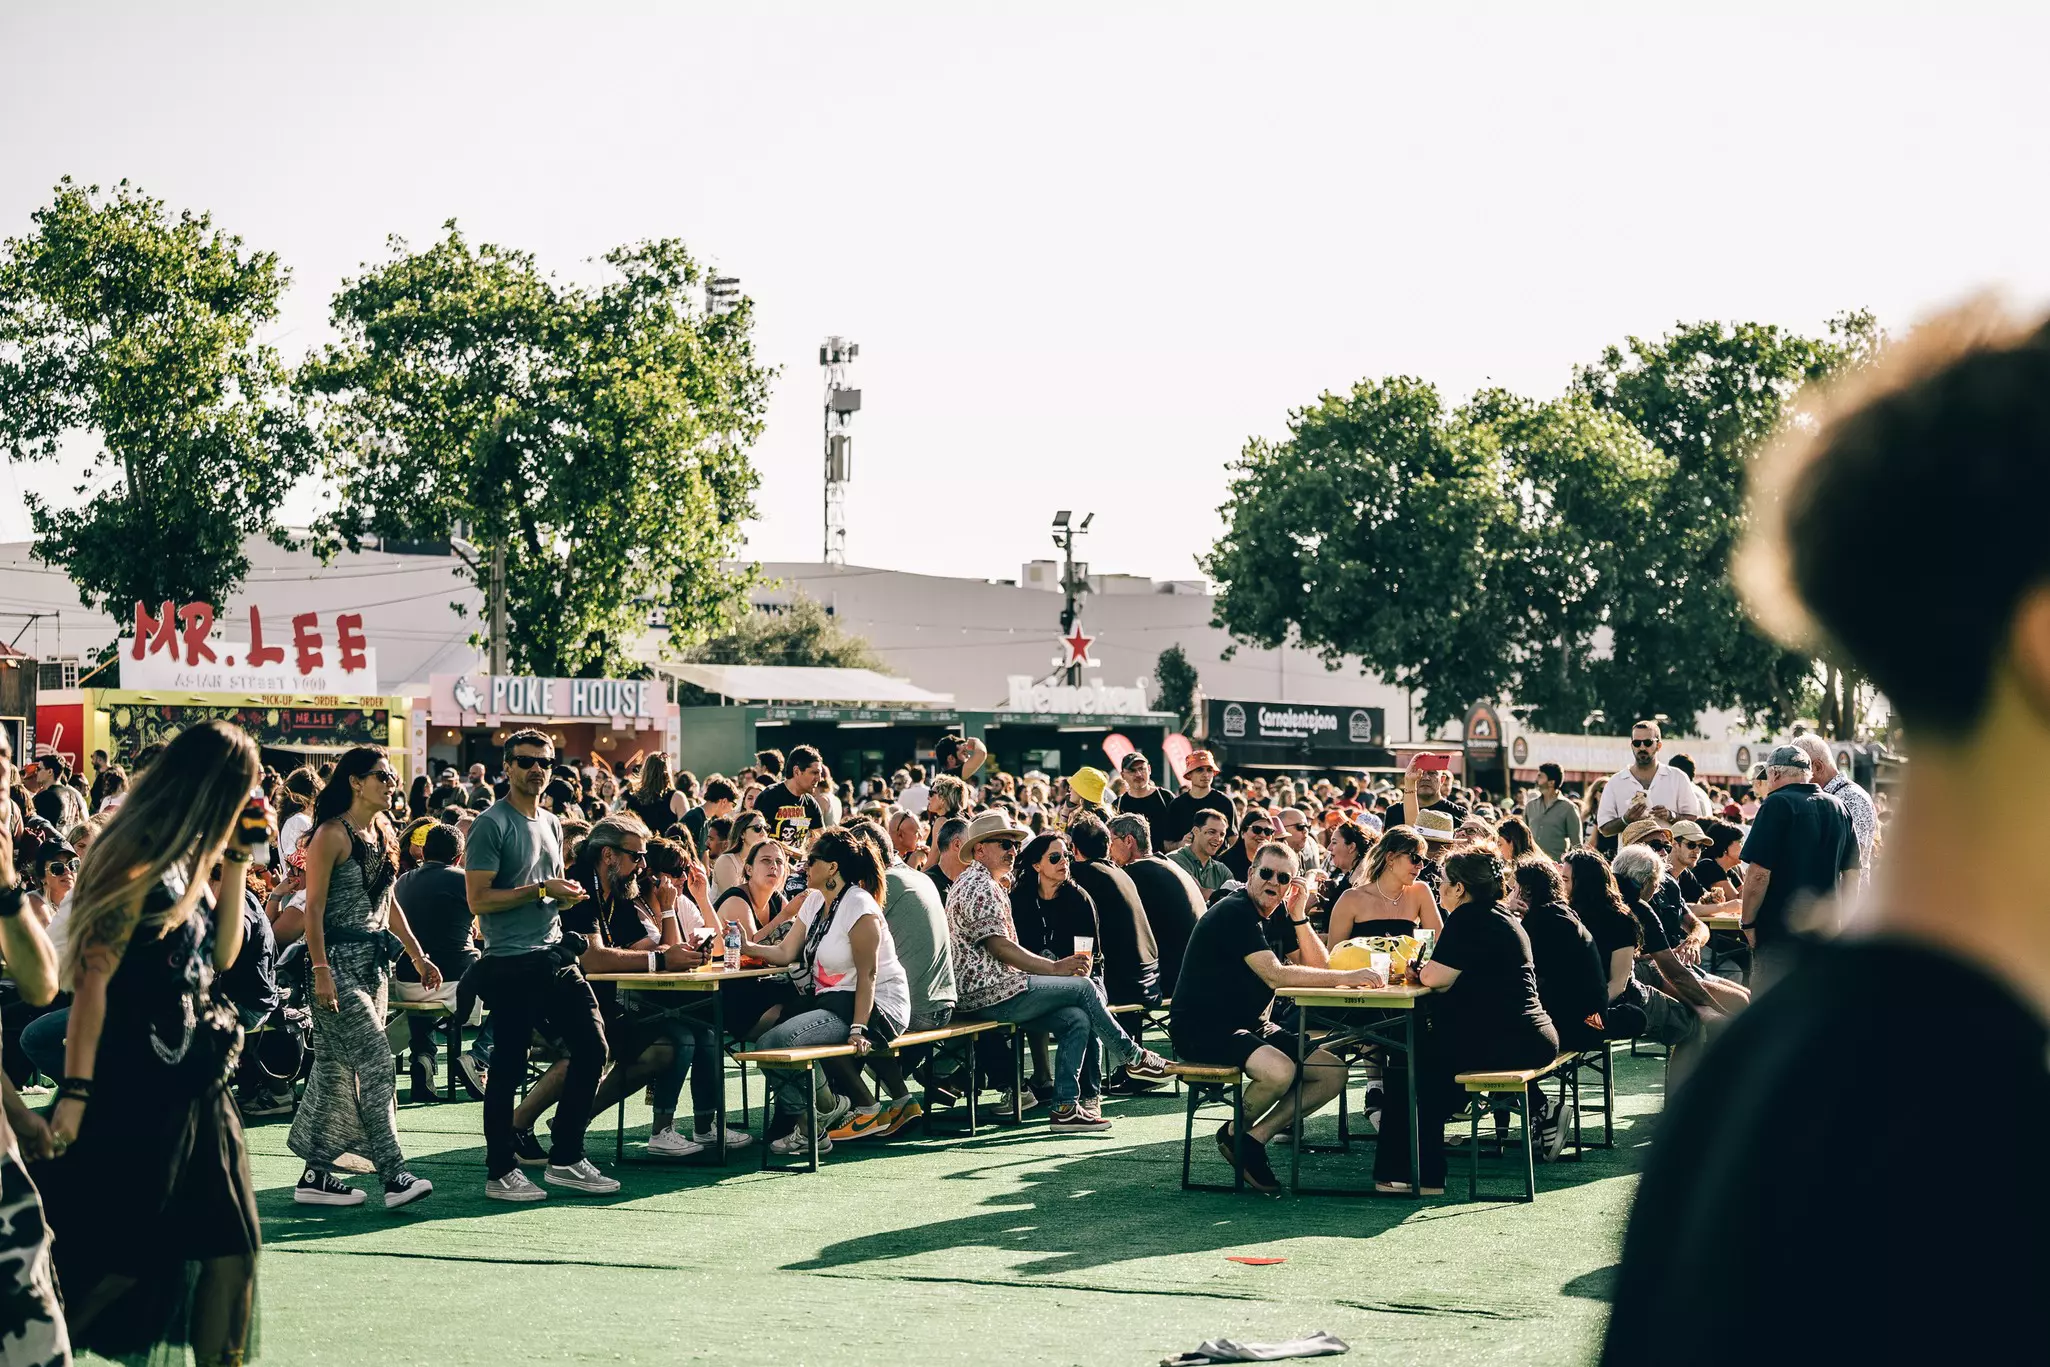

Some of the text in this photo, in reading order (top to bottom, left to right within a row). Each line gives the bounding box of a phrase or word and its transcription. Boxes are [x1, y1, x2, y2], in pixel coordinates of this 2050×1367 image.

[262, 695, 293, 706] PICK-UP
[314, 696, 339, 706] ORDER
[359, 697, 385, 707] ORDER
[490, 677, 650, 717] POKE HOUSE
[1258, 706, 1338, 734] Carnalentejana
